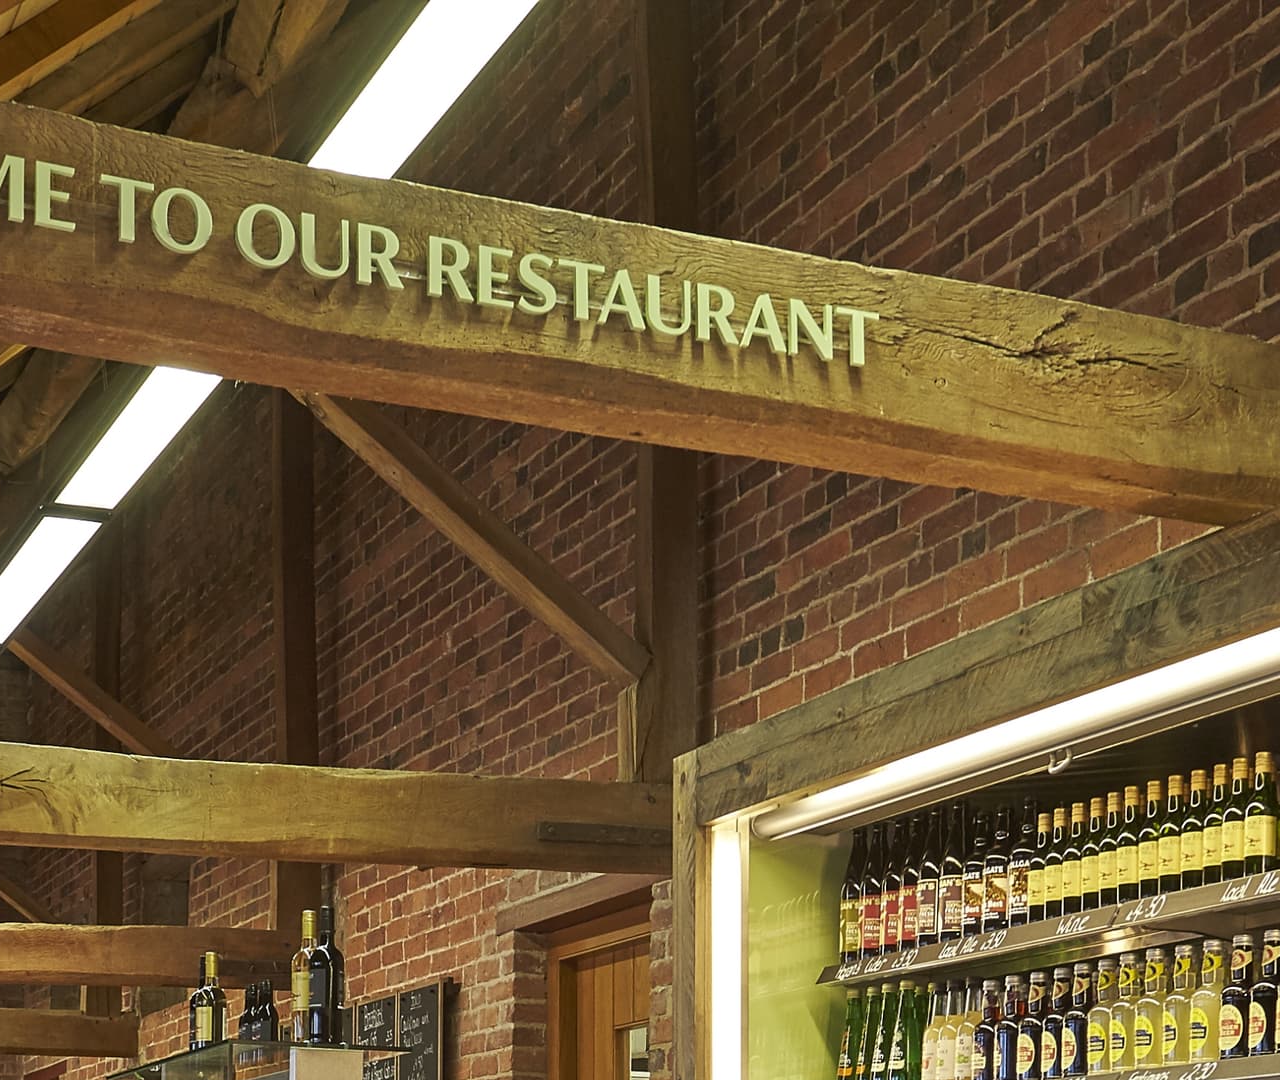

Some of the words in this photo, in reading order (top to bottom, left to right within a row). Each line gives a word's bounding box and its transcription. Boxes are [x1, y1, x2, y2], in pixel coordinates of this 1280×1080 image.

[99, 173, 215, 256] TO
[234, 203, 406, 291] OUR
[427, 234, 880, 368] RESTAURANT
